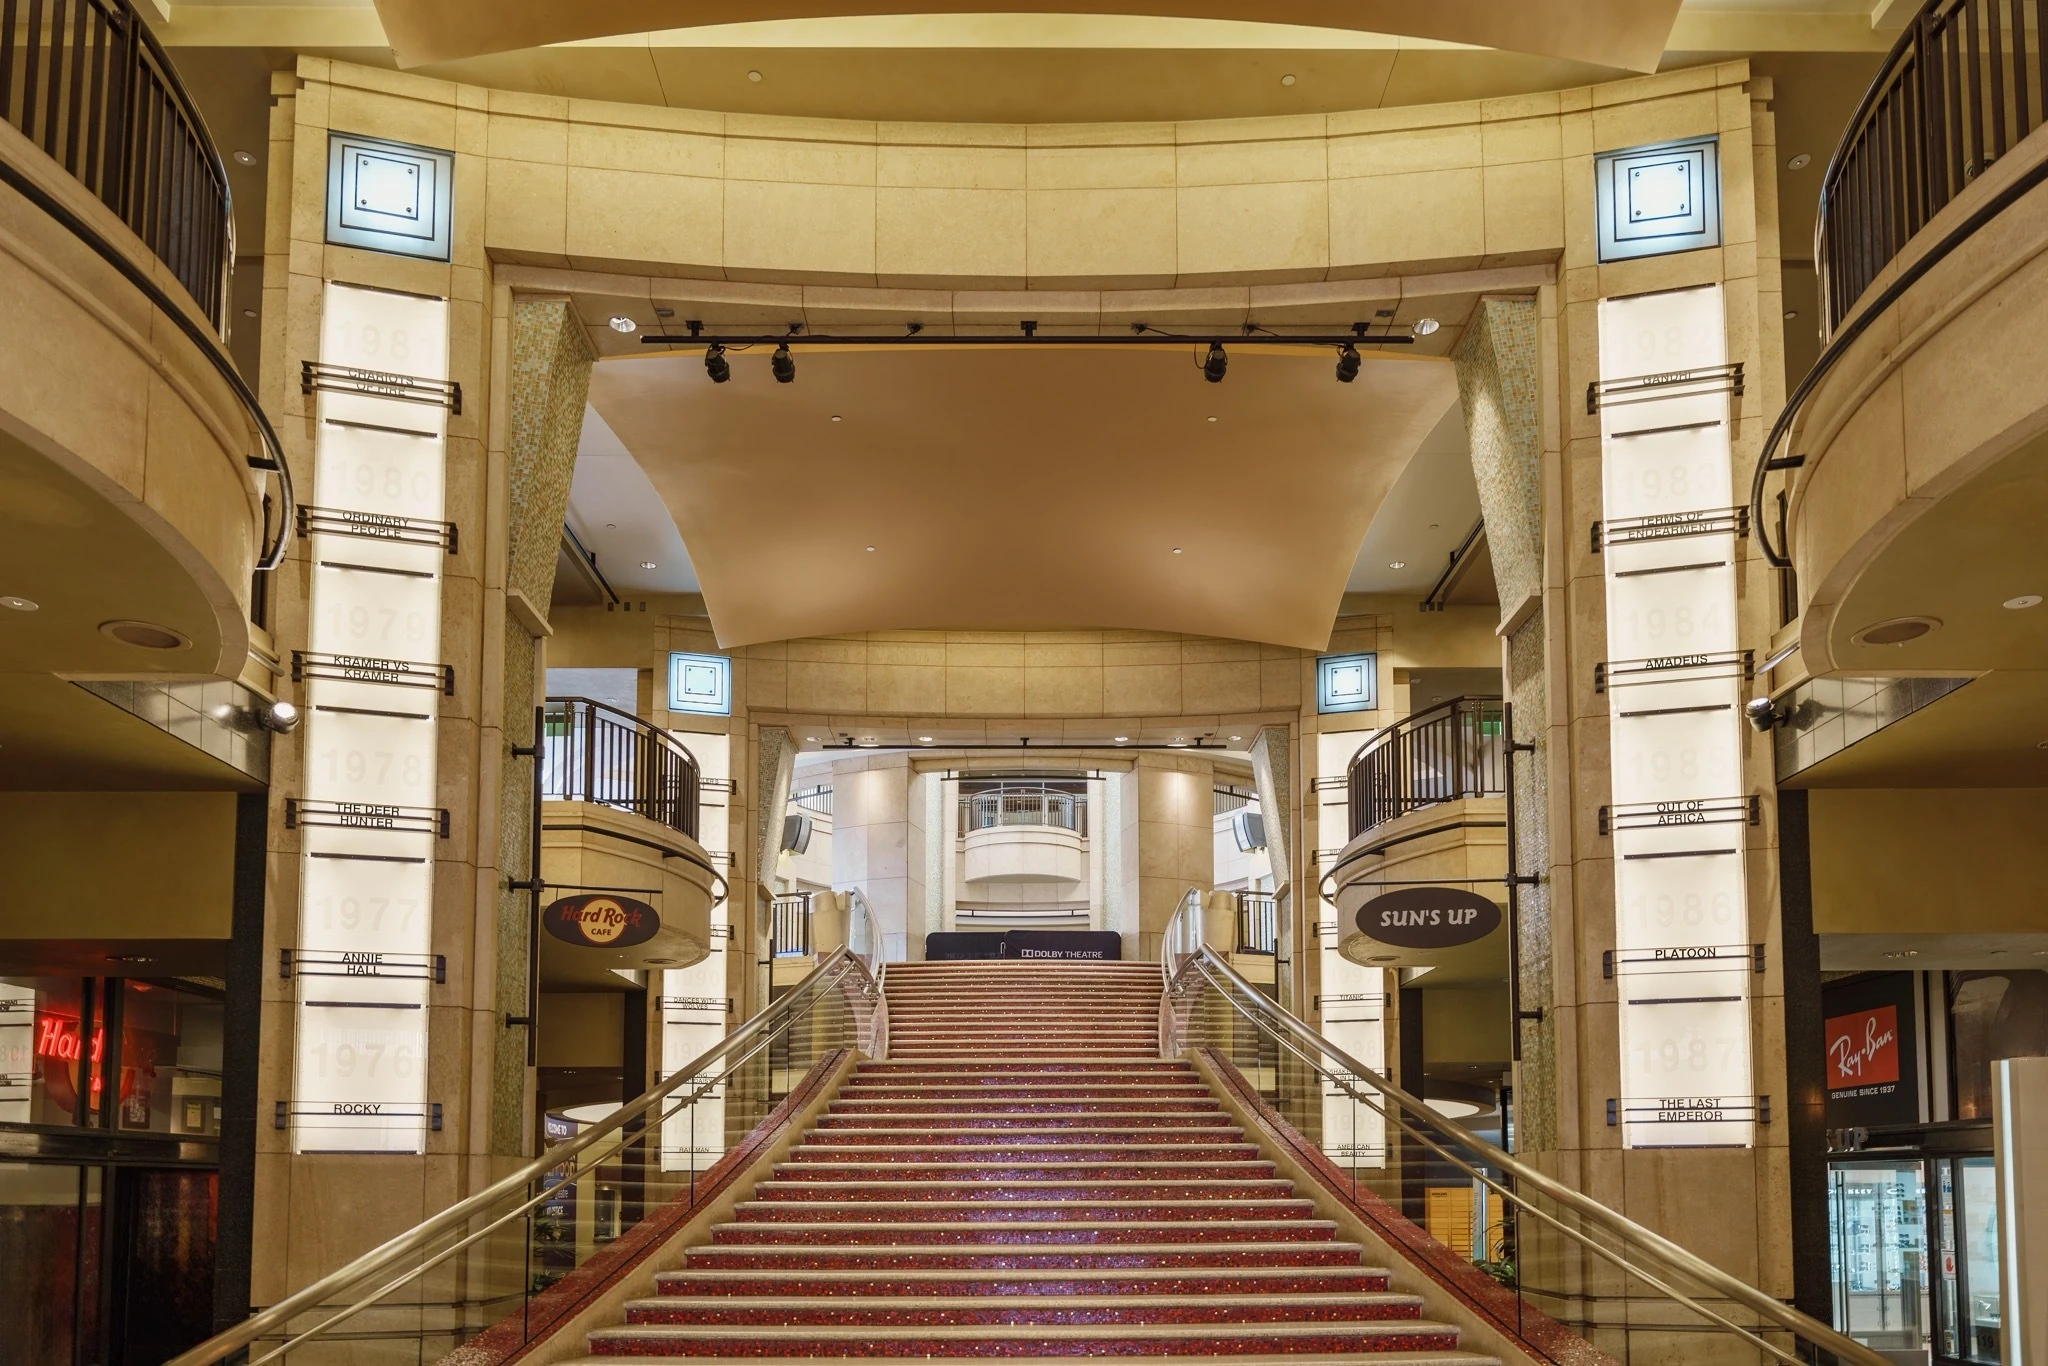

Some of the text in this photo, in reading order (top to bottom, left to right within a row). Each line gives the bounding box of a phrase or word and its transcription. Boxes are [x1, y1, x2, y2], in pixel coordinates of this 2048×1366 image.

[348, 368, 414, 386] CHARIOTS
[1642, 371, 1692, 386] GANDHI
[331, 460, 430, 502] 1980
[342, 510, 410, 528] ORDINARY
[1639, 510, 1704, 527] TERMS OF
[351, 523, 402, 539] PEOPLE
[1628, 521, 1716, 540] ENDEARMENT
[327, 602, 425, 643] 1979
[1624, 603, 1721, 642] 1984
[334, 655, 410, 672] KRAMER VS
[1645, 653, 1708, 670] AMADEUS
[344, 667, 399, 683] KRAMER
[321, 748, 422, 787] 1978
[335, 802, 400, 817] THE DEER
[1656, 800, 1705, 813] OUT OF
[340, 815, 394, 829] HUNTER
[1658, 812, 1706, 826] AFRICA
[316, 894, 419, 932] 1977
[560, 904, 642, 928] Hard Rock
[1380, 908, 1478, 927] SUN'S UP
[1631, 891, 1732, 929] 1986
[591, 928, 612, 936] CAFE
[342, 952, 383, 964] ANNIE
[1034, 950, 1103, 958] DOLBY THEATRE
[1655, 947, 1716, 960] PLATOON
[346, 964, 381, 976] HALL
[674, 996, 717, 1005] DANCES WITH
[310, 1042, 414, 1078] 1976
[1637, 1038, 1737, 1074] 1987
[1831, 1085, 1896, 1099] GENUINE SINCE 1937
[334, 1103, 381, 1115] ROCKY
[1659, 1098, 1722, 1110] THE LAST
[1658, 1111, 1723, 1122] EMPEROR
